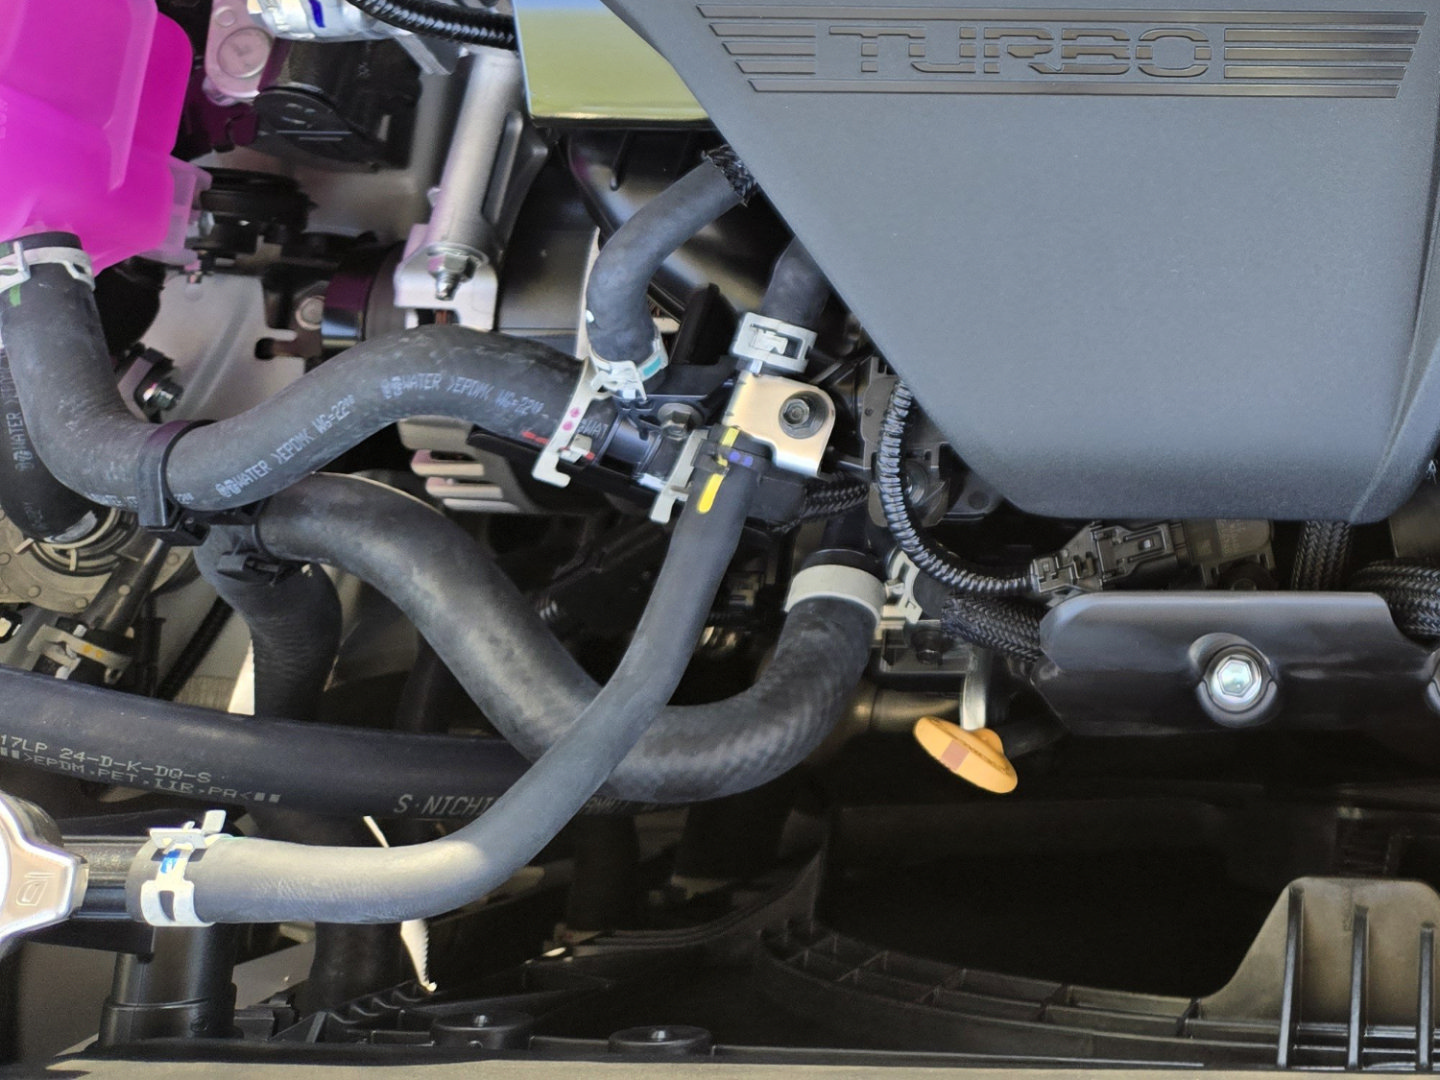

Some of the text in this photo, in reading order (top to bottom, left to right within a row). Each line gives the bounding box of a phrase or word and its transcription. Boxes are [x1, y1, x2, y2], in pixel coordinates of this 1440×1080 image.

[829, 26, 1212, 77] TURBO
[231, 459, 273, 489] WATER
[59, 747, 212, 784] 24-D-K-DQ-S
